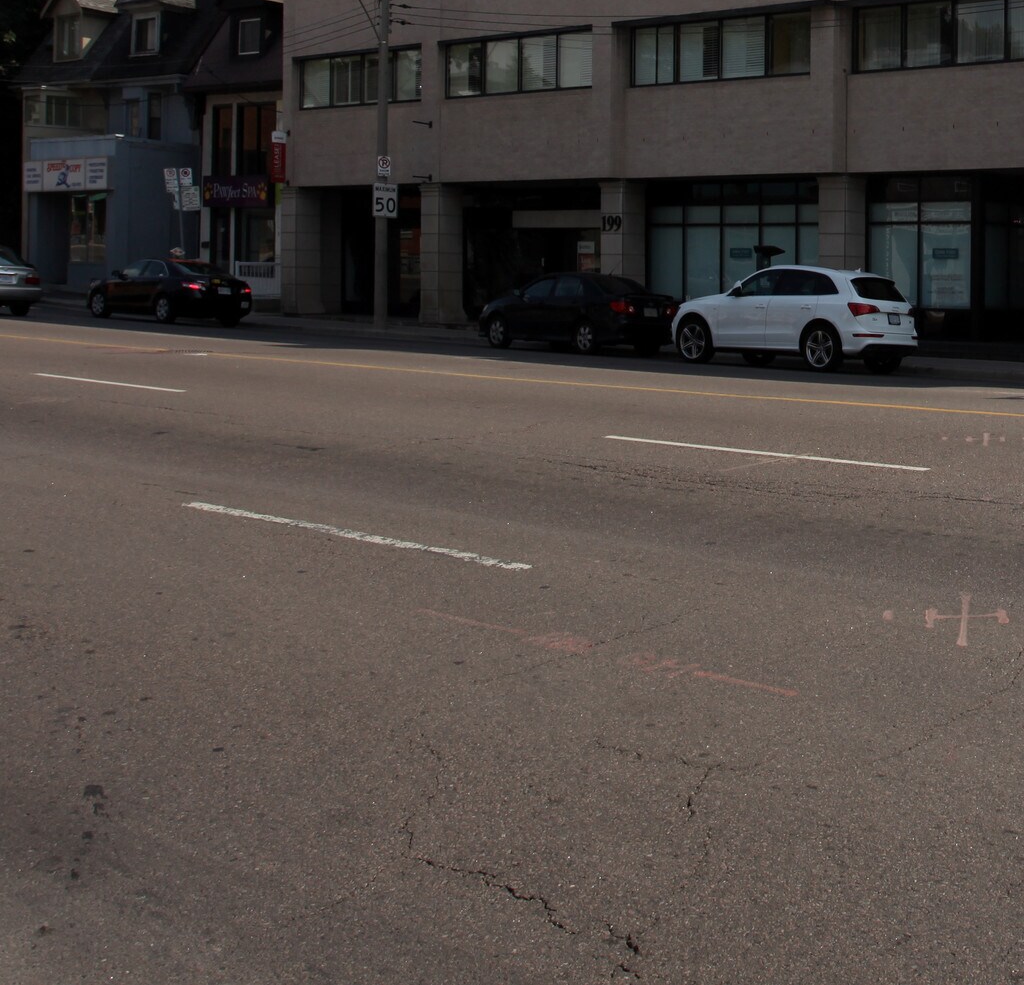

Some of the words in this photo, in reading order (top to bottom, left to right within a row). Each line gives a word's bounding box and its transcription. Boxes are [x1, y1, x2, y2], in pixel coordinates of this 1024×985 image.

[241, 182, 257, 199] SPA
[375, 197, 396, 213] 50
[601, 215, 622, 232] 199
